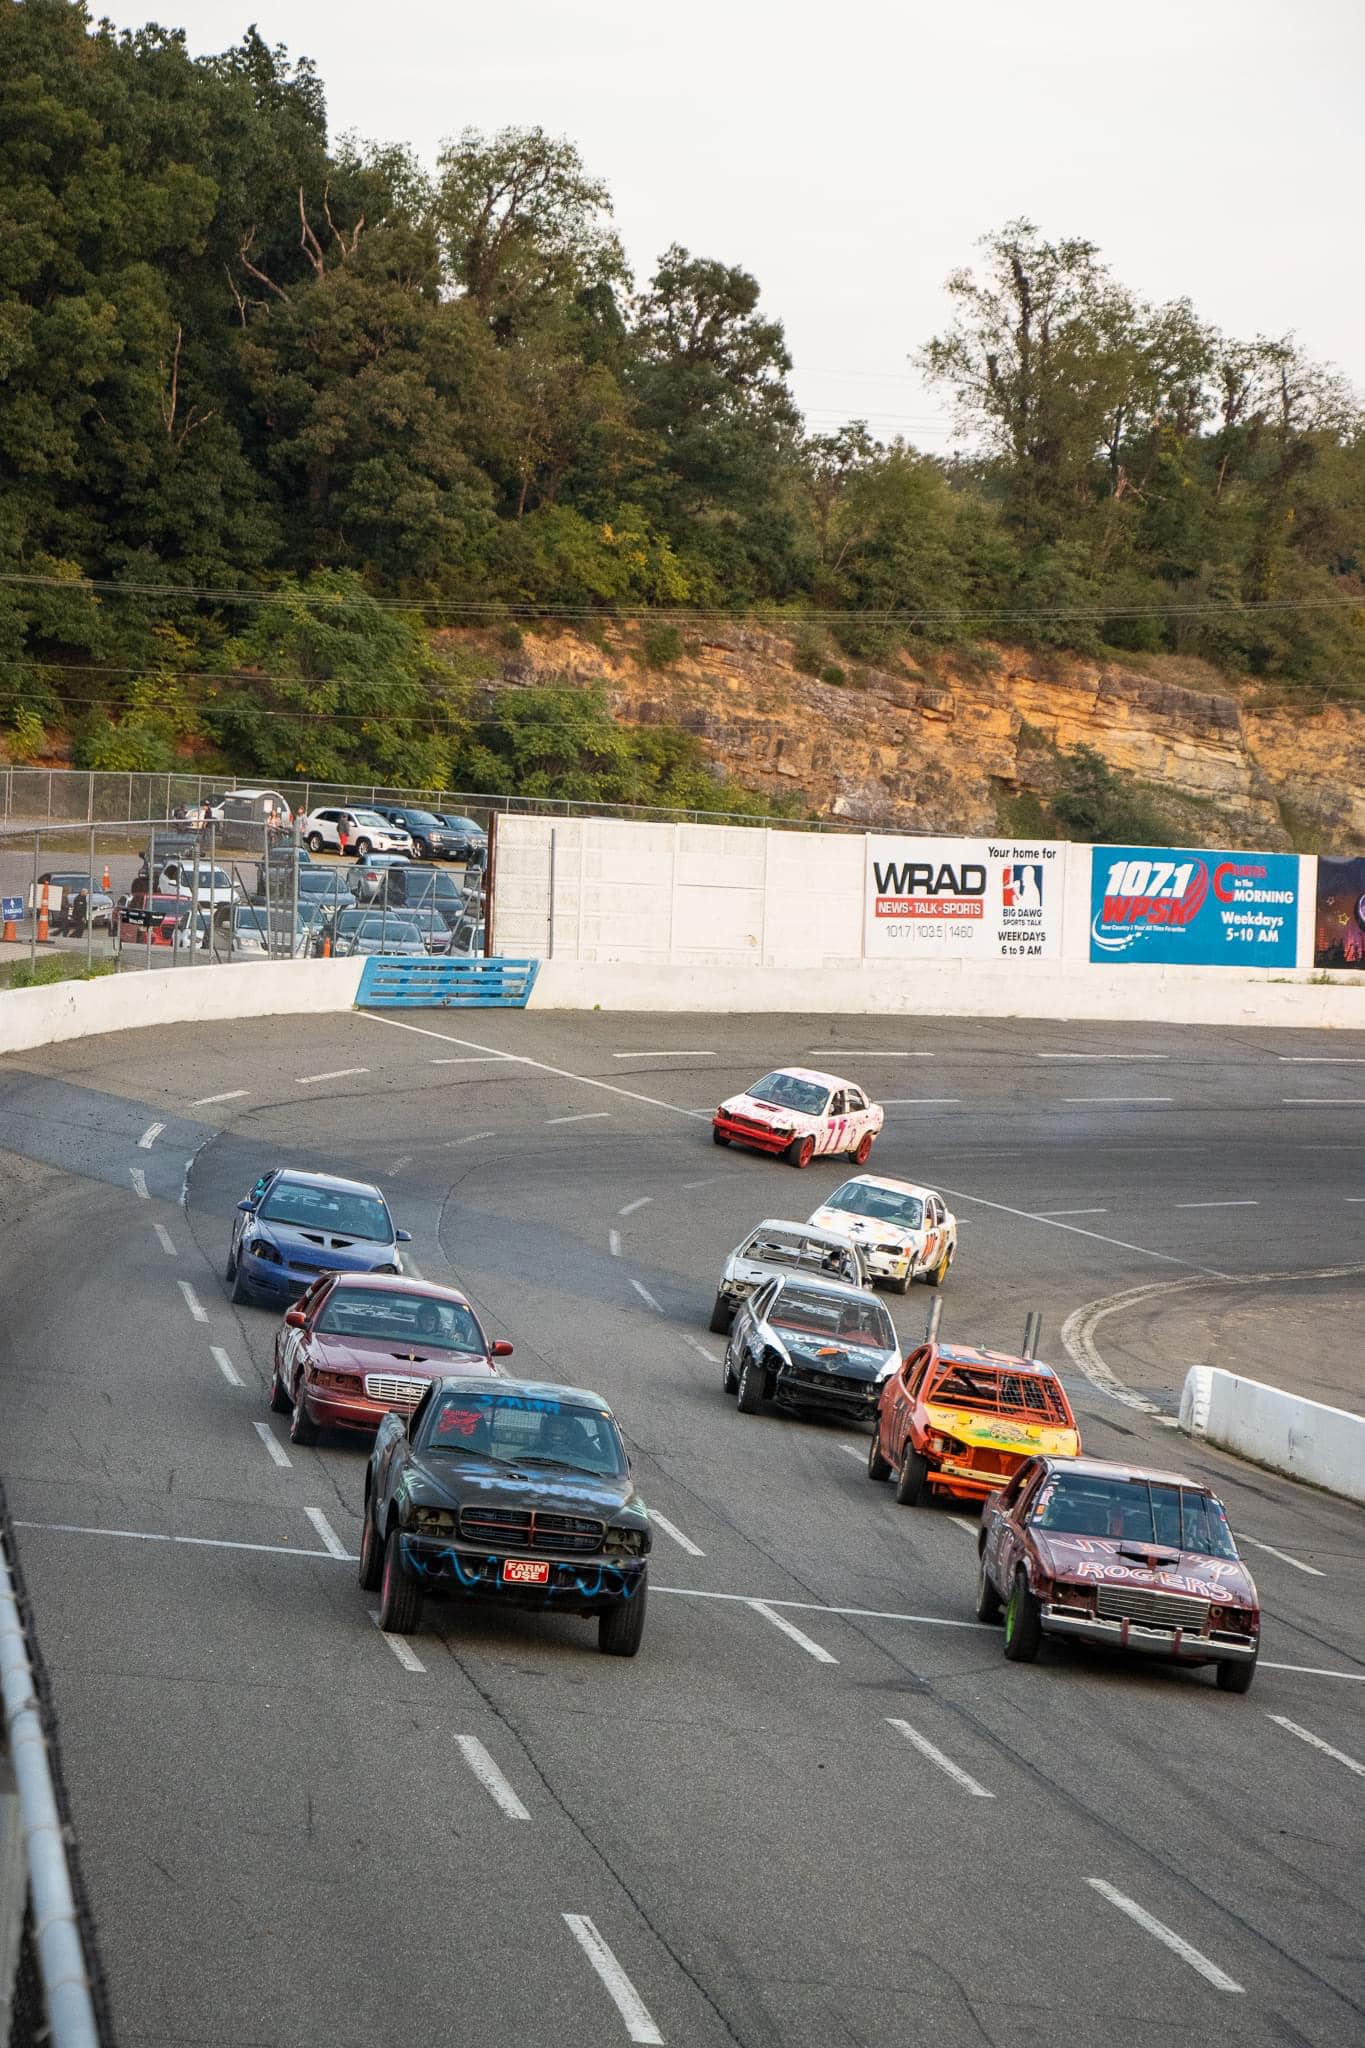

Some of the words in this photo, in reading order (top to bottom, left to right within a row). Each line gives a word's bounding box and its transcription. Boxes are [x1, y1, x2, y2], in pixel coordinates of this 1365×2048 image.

[988, 846, 1010, 859] Your
[1012, 847, 1040, 859] home
[1042, 848, 1057, 859] for
[873, 862, 987, 896] WRAD
[1105, 861, 1195, 898] 107.1
[1233, 889, 1294, 904] MORNING
[878, 901, 909, 914] NEWS
[914, 902, 938, 914] TALK
[943, 902, 981, 915] SPORTS
[1003, 908, 1016, 917] BIG
[1018, 908, 1042, 918] DAWG
[1221, 911, 1284, 929] Weekdays
[948, 926, 974, 939] 1460
[998, 931, 1046, 942] WEEKDAYS
[1226, 928, 1254, 942] 5-10
[1258, 929, 1279, 943] AM
[1001, 945, 1007, 955] 6
[1009, 946, 1018, 955] to
[1019, 945, 1025, 955] 9
[1027, 946, 1042, 956] AM
[507, 1562, 546, 1574] FARM
[511, 1570, 540, 1580] USE
[1077, 1561, 1233, 1602] ROGERS
